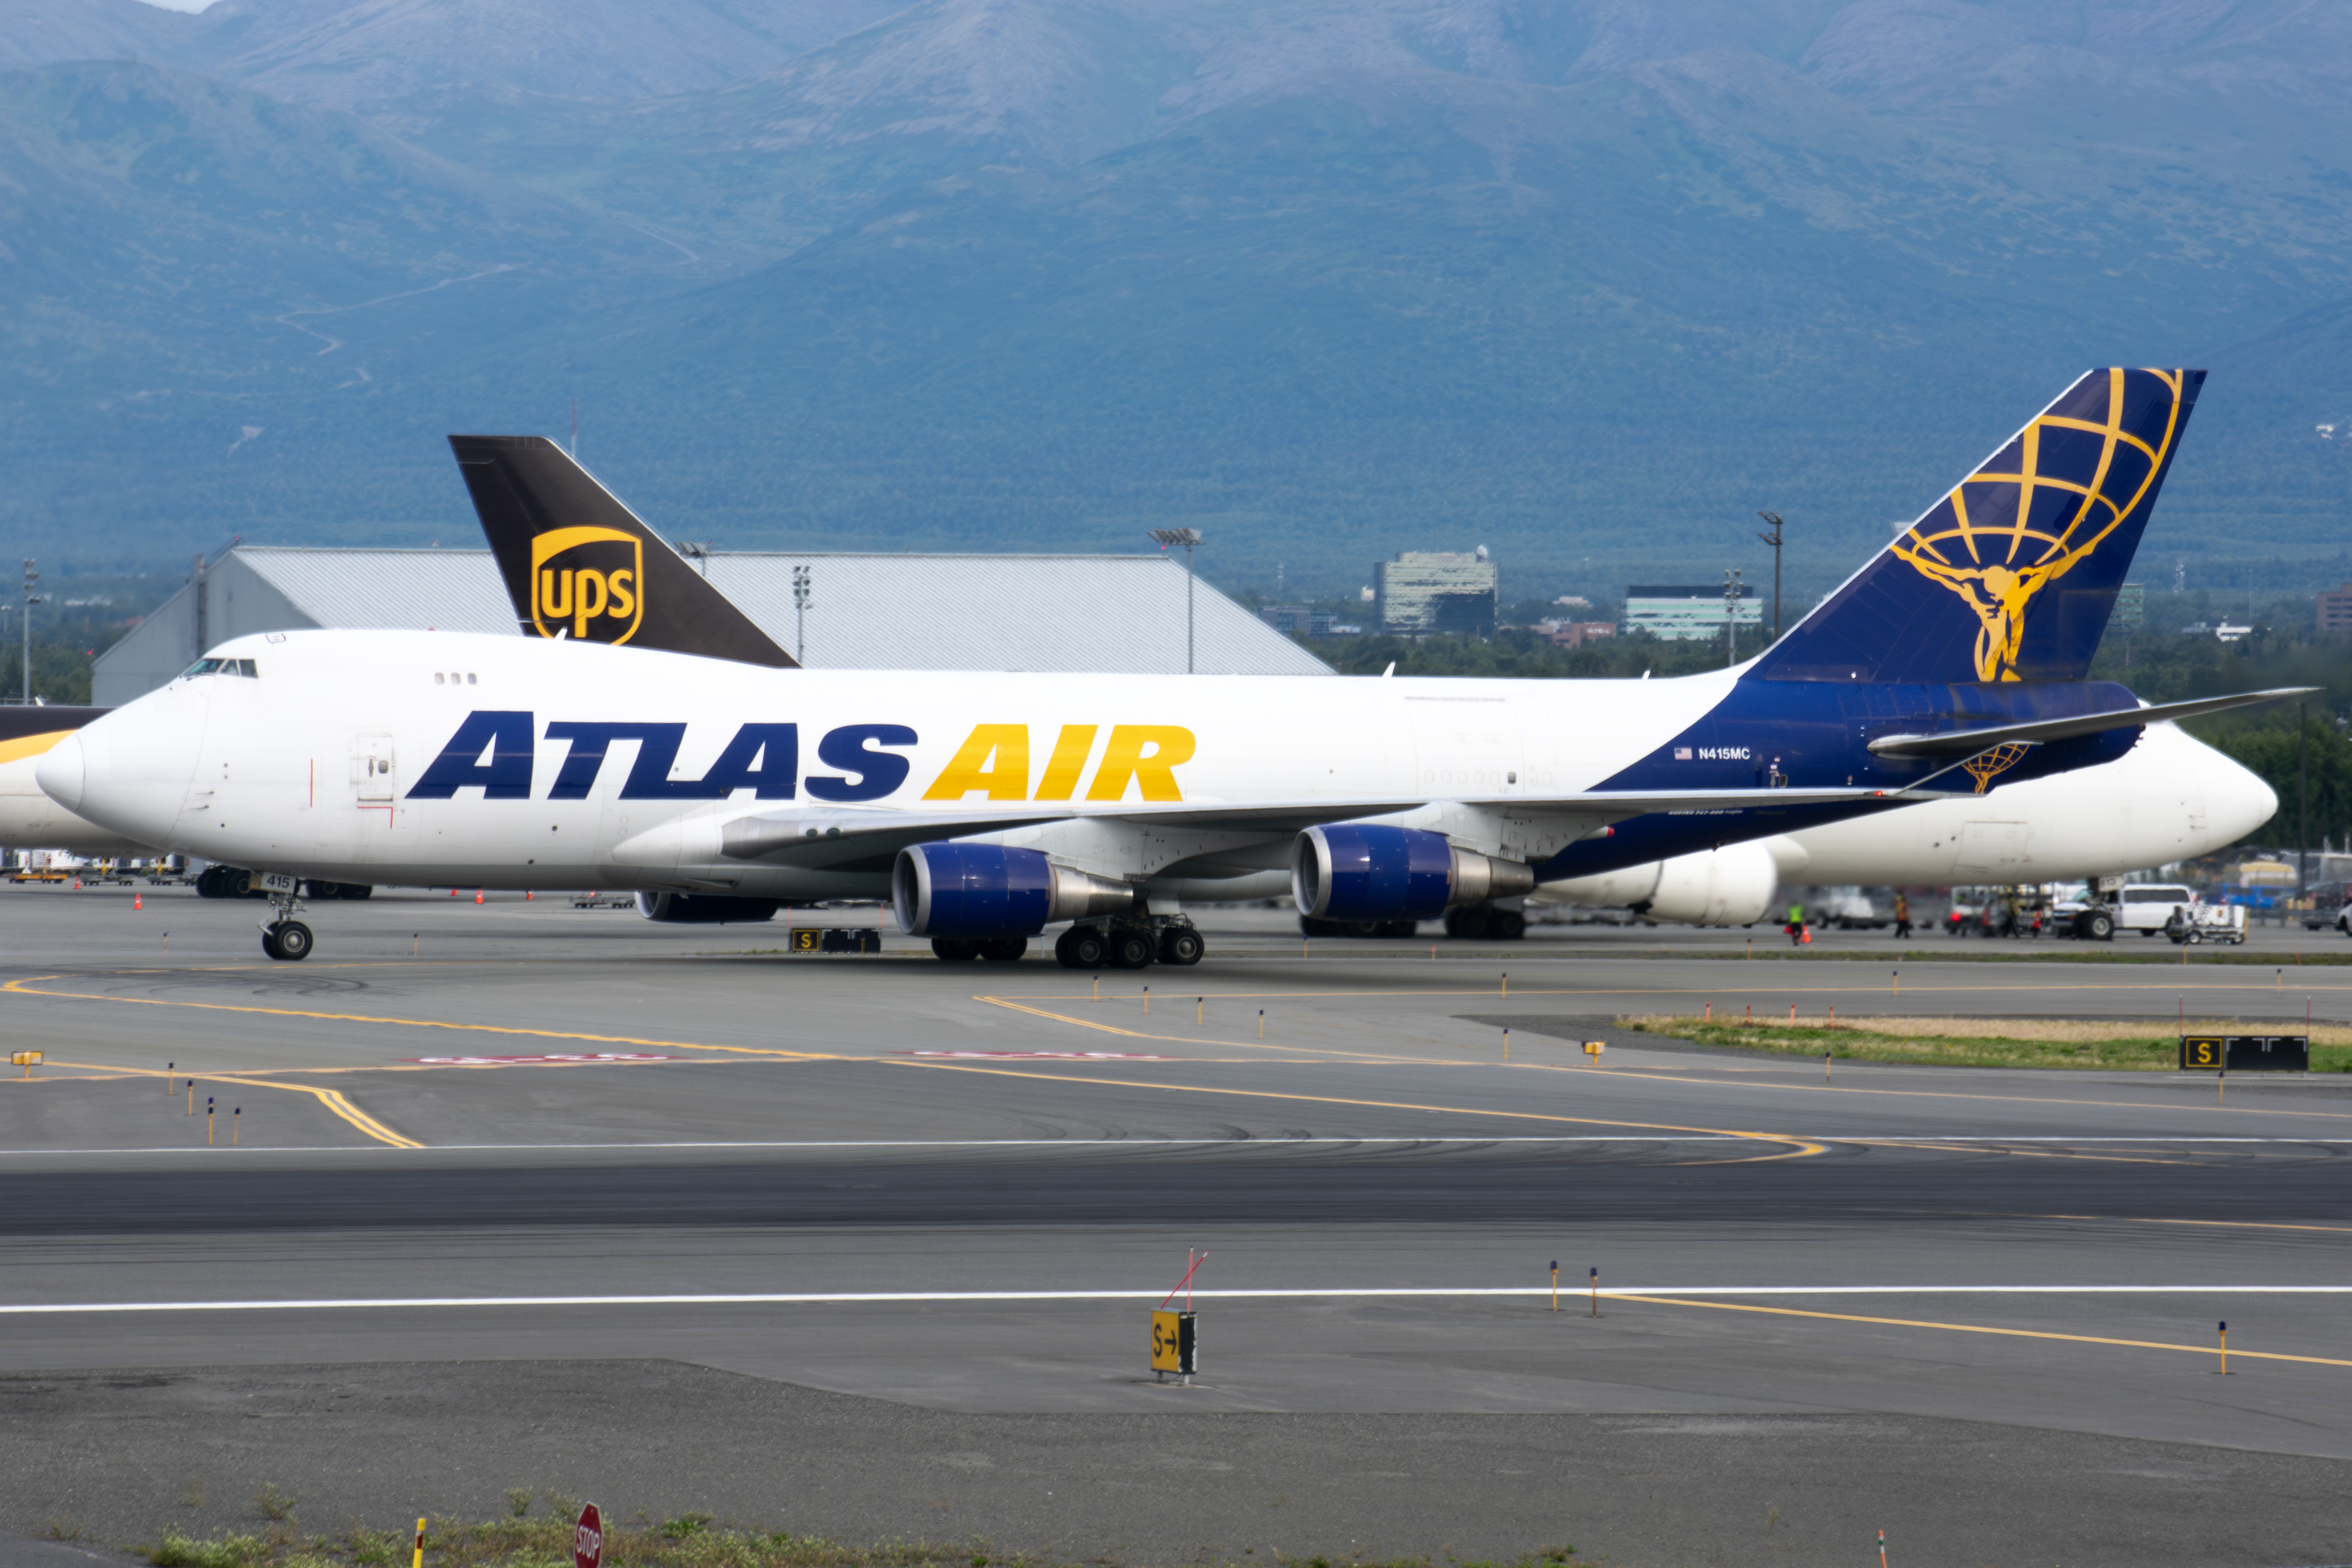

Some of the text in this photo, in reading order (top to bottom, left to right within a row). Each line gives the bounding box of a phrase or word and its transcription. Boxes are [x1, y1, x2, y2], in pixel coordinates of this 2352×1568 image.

[541, 568, 635, 638] ups
[404, 710, 1196, 802] ATLAS AIR
[1699, 747, 1751, 760] N415MC
[267, 875, 290, 889] 415
[801, 933, 812, 949] S
[2197, 1042, 2212, 1063] S
[1154, 1323, 1163, 1359] S
[577, 1525, 600, 1560] STOP
